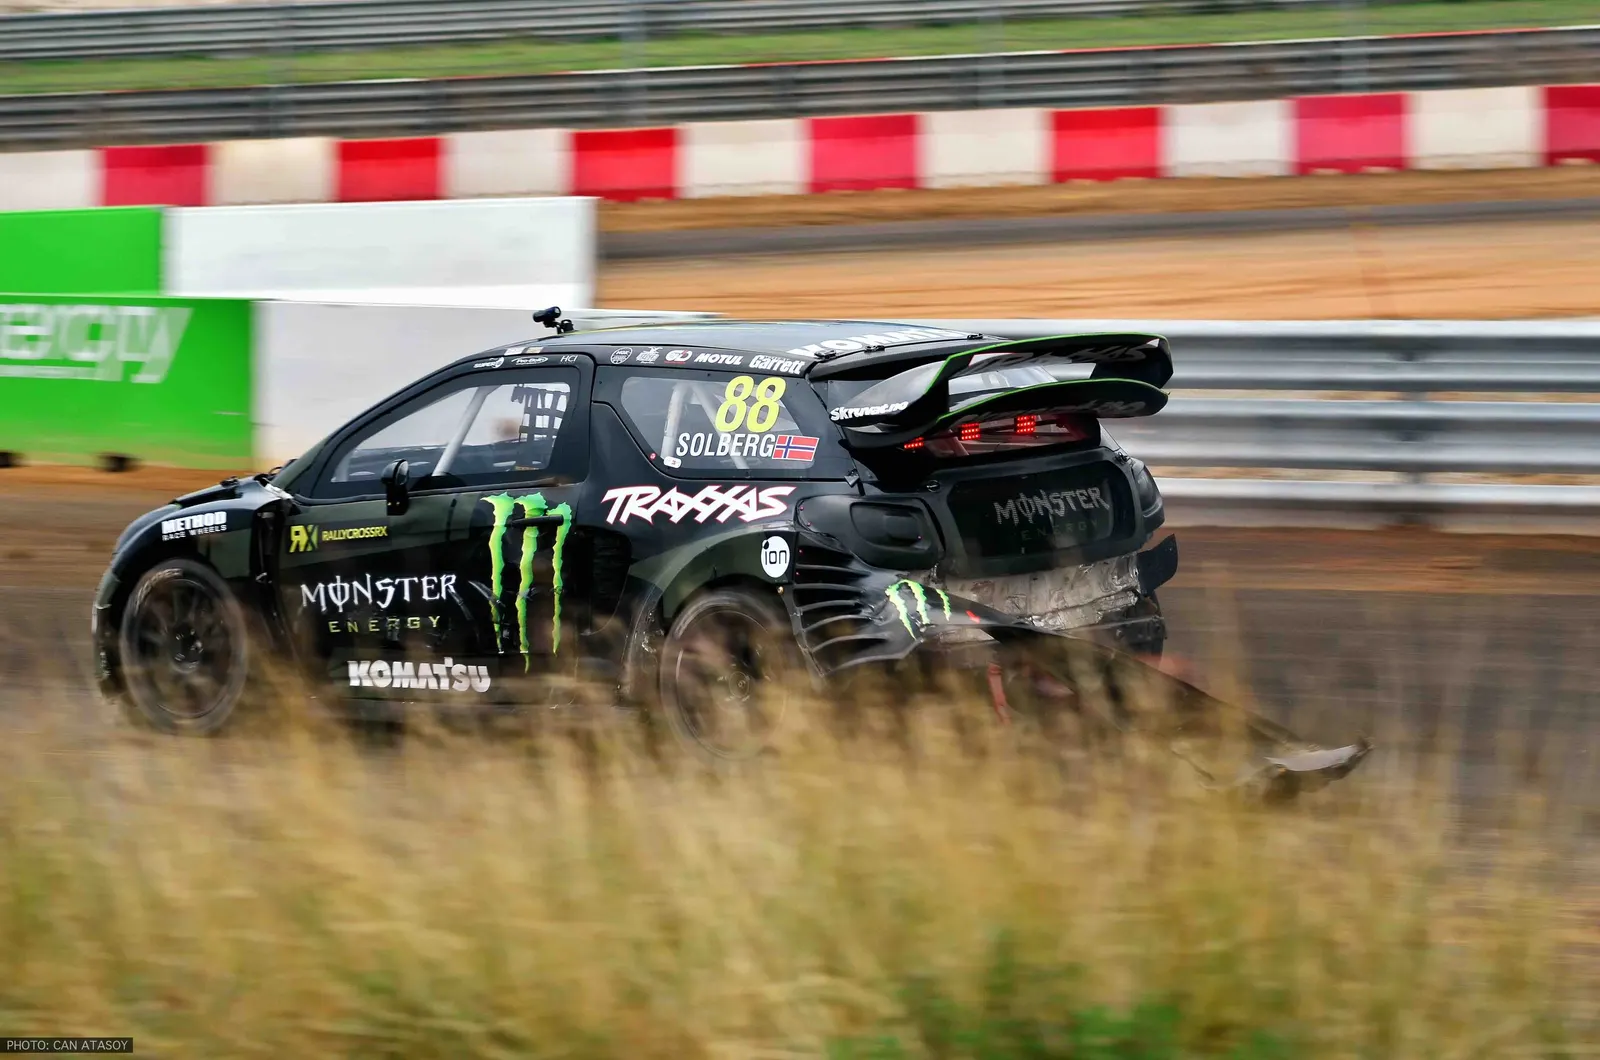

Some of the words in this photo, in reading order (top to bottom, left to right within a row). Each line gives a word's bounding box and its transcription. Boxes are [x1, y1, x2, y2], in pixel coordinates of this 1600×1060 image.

[694, 352, 744, 365] MOTUL
[749, 354, 806, 375] Garrett
[714, 375, 787, 433] 88
[676, 432, 776, 458] SOLBERG
[600, 485, 797, 526] TRAXXAS
[992, 486, 1111, 526] MONSTER
[161, 511, 227, 535] METHOD
[162, 529, 185, 541] RACE
[189, 524, 227, 537] WHEELS
[322, 525, 388, 542] RALLYCROSSRX
[762, 539, 788, 566] ion
[301, 573, 458, 613] MONSTER
[328, 615, 441, 634] ENERGY
[347, 656, 492, 694] KOMATSU
